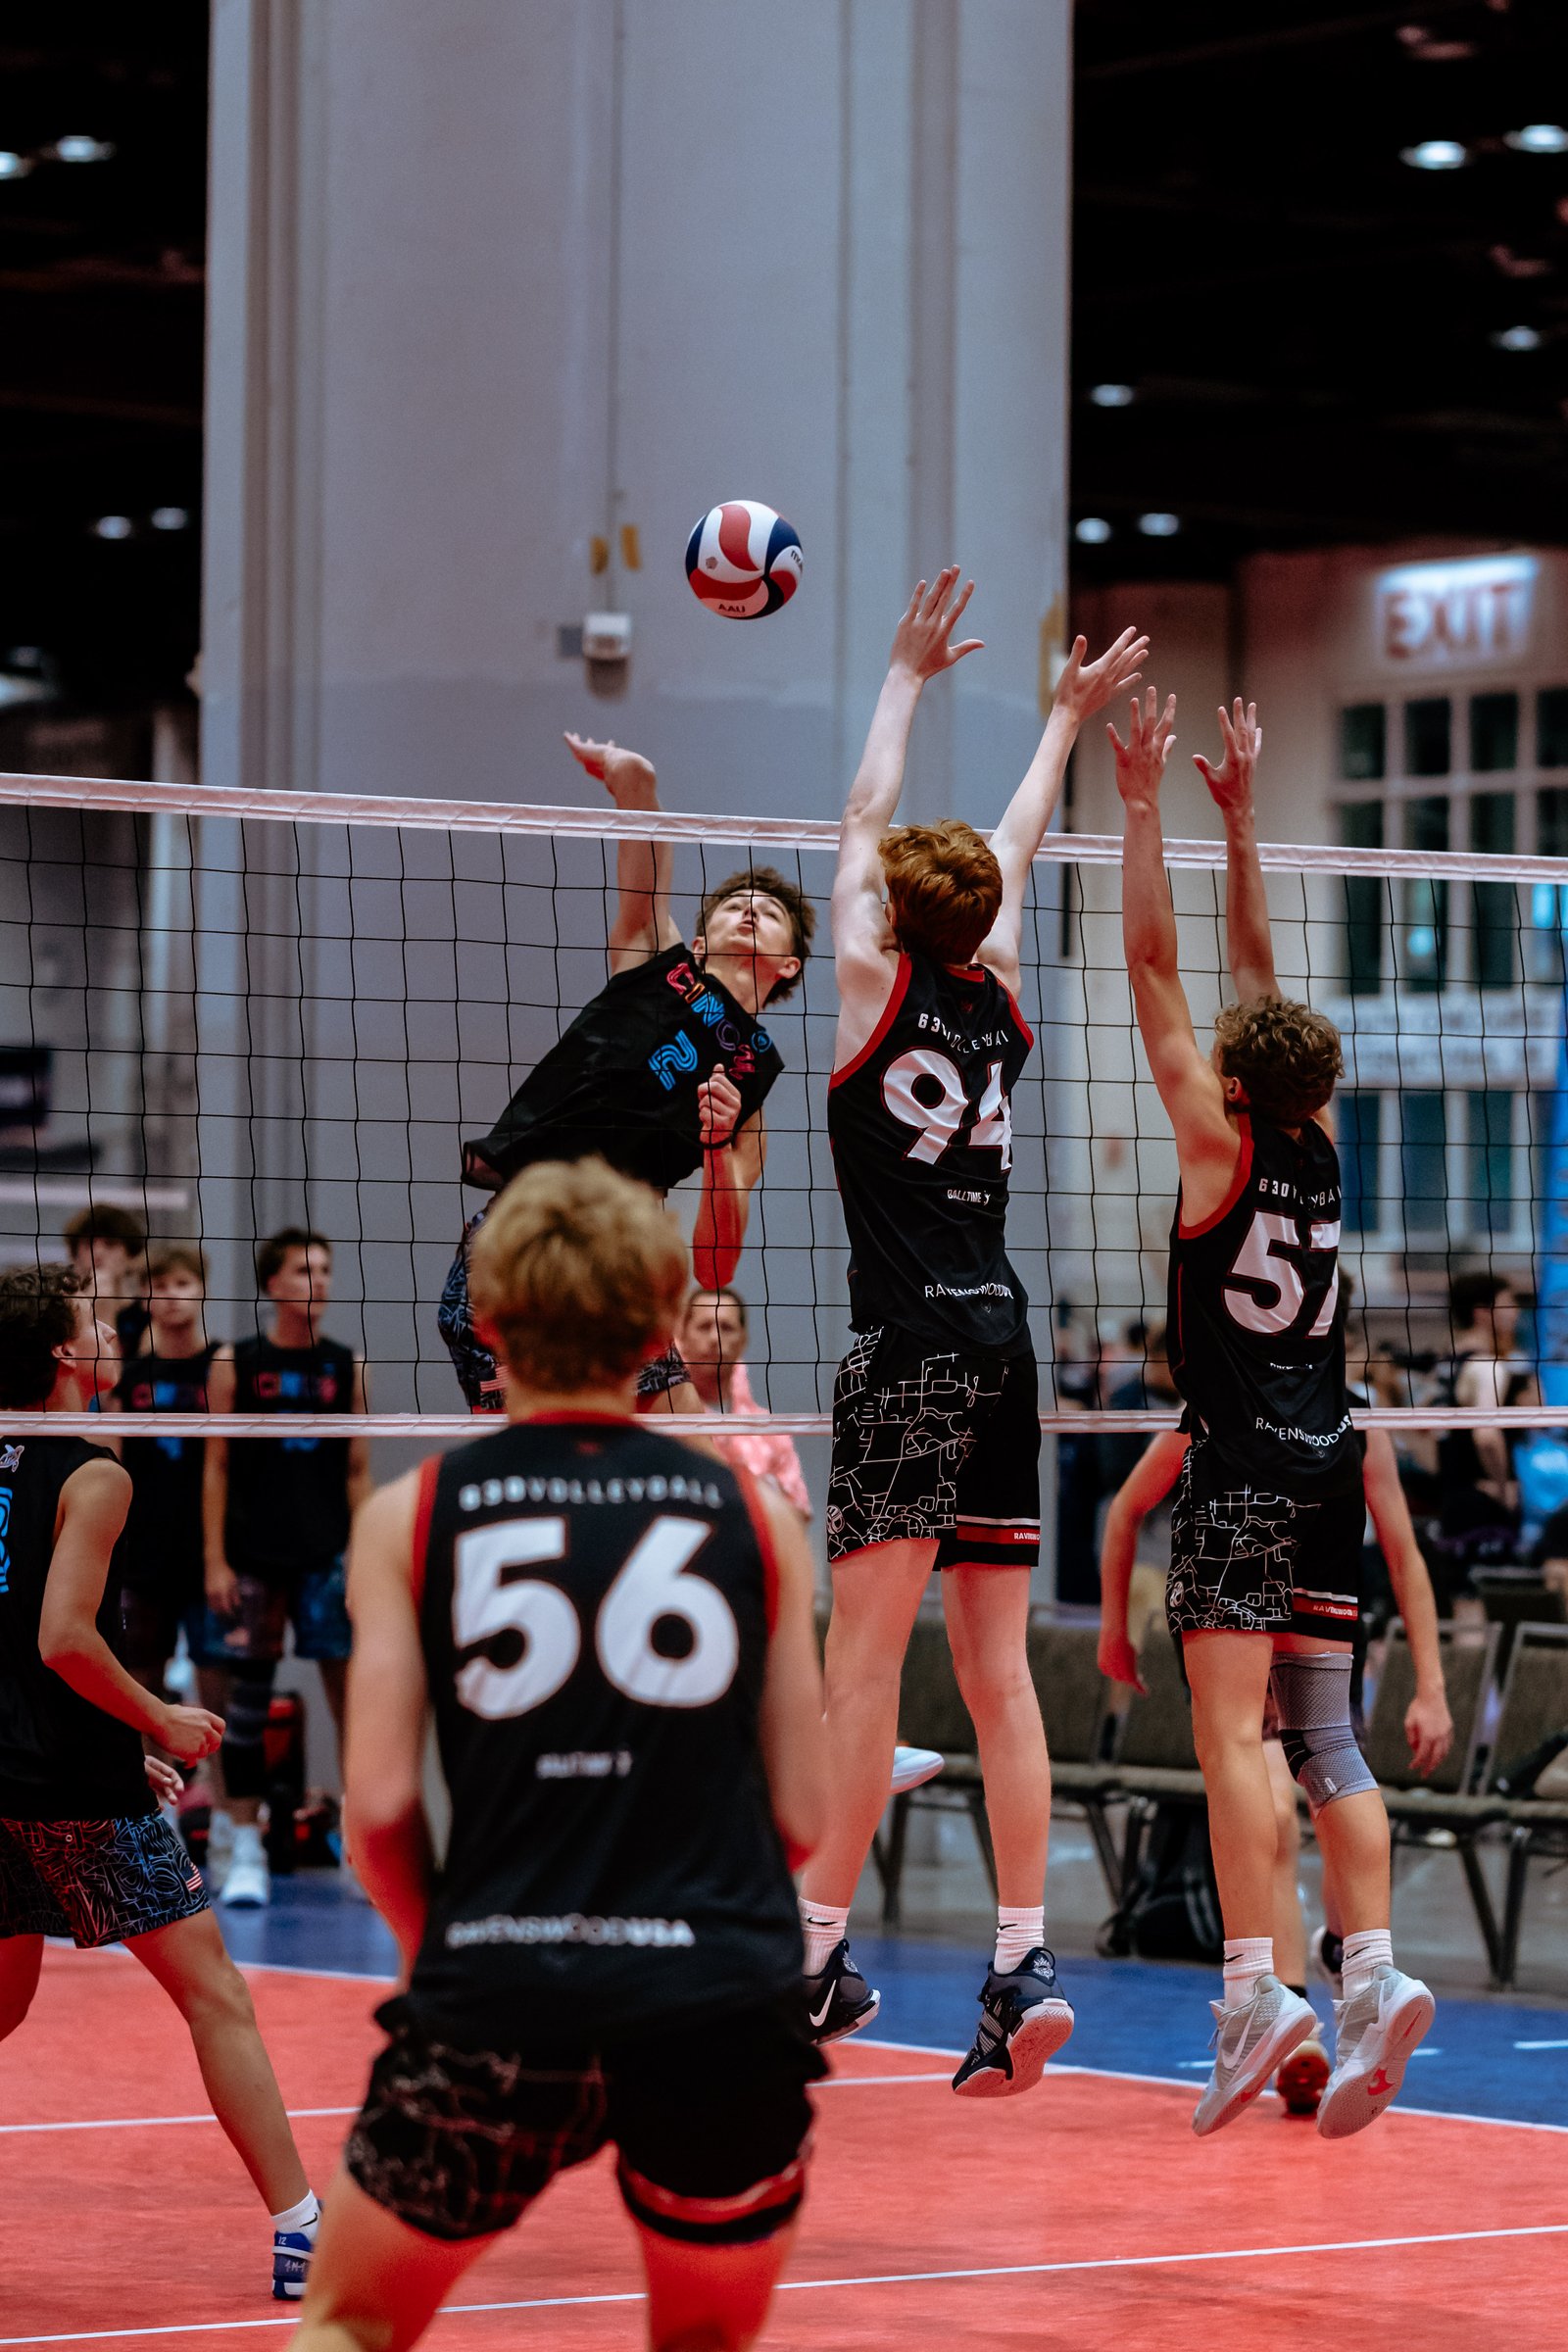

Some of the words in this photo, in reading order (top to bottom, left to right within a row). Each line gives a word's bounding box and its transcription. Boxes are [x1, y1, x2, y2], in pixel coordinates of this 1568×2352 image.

[1385, 584, 1516, 660] EXIT
[883, 1049, 1012, 1171] 94
[1223, 1210, 1342, 1337] 57
[452, 1514, 740, 1722] 56
